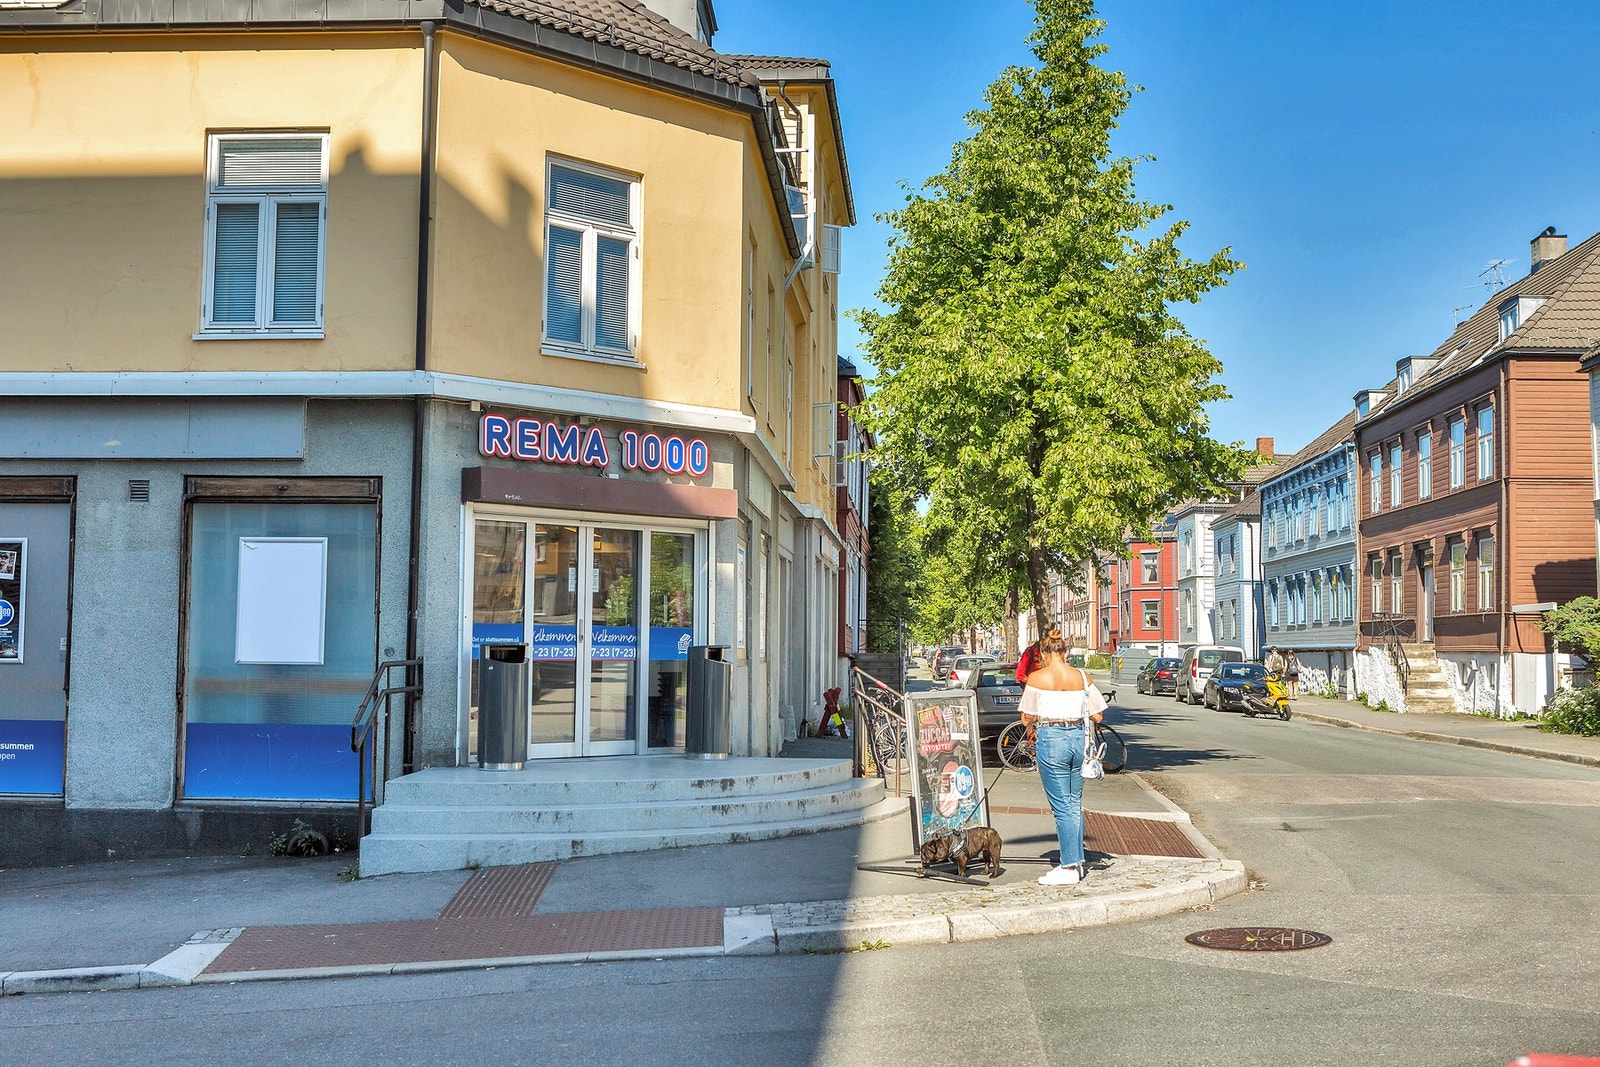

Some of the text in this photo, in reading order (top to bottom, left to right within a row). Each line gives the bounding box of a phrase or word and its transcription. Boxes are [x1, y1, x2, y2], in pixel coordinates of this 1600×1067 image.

[479, 413, 711, 478] REMA 1000
[532, 647, 549, 657] -23
[592, 647, 637, 658] 7-23 (7-23)
